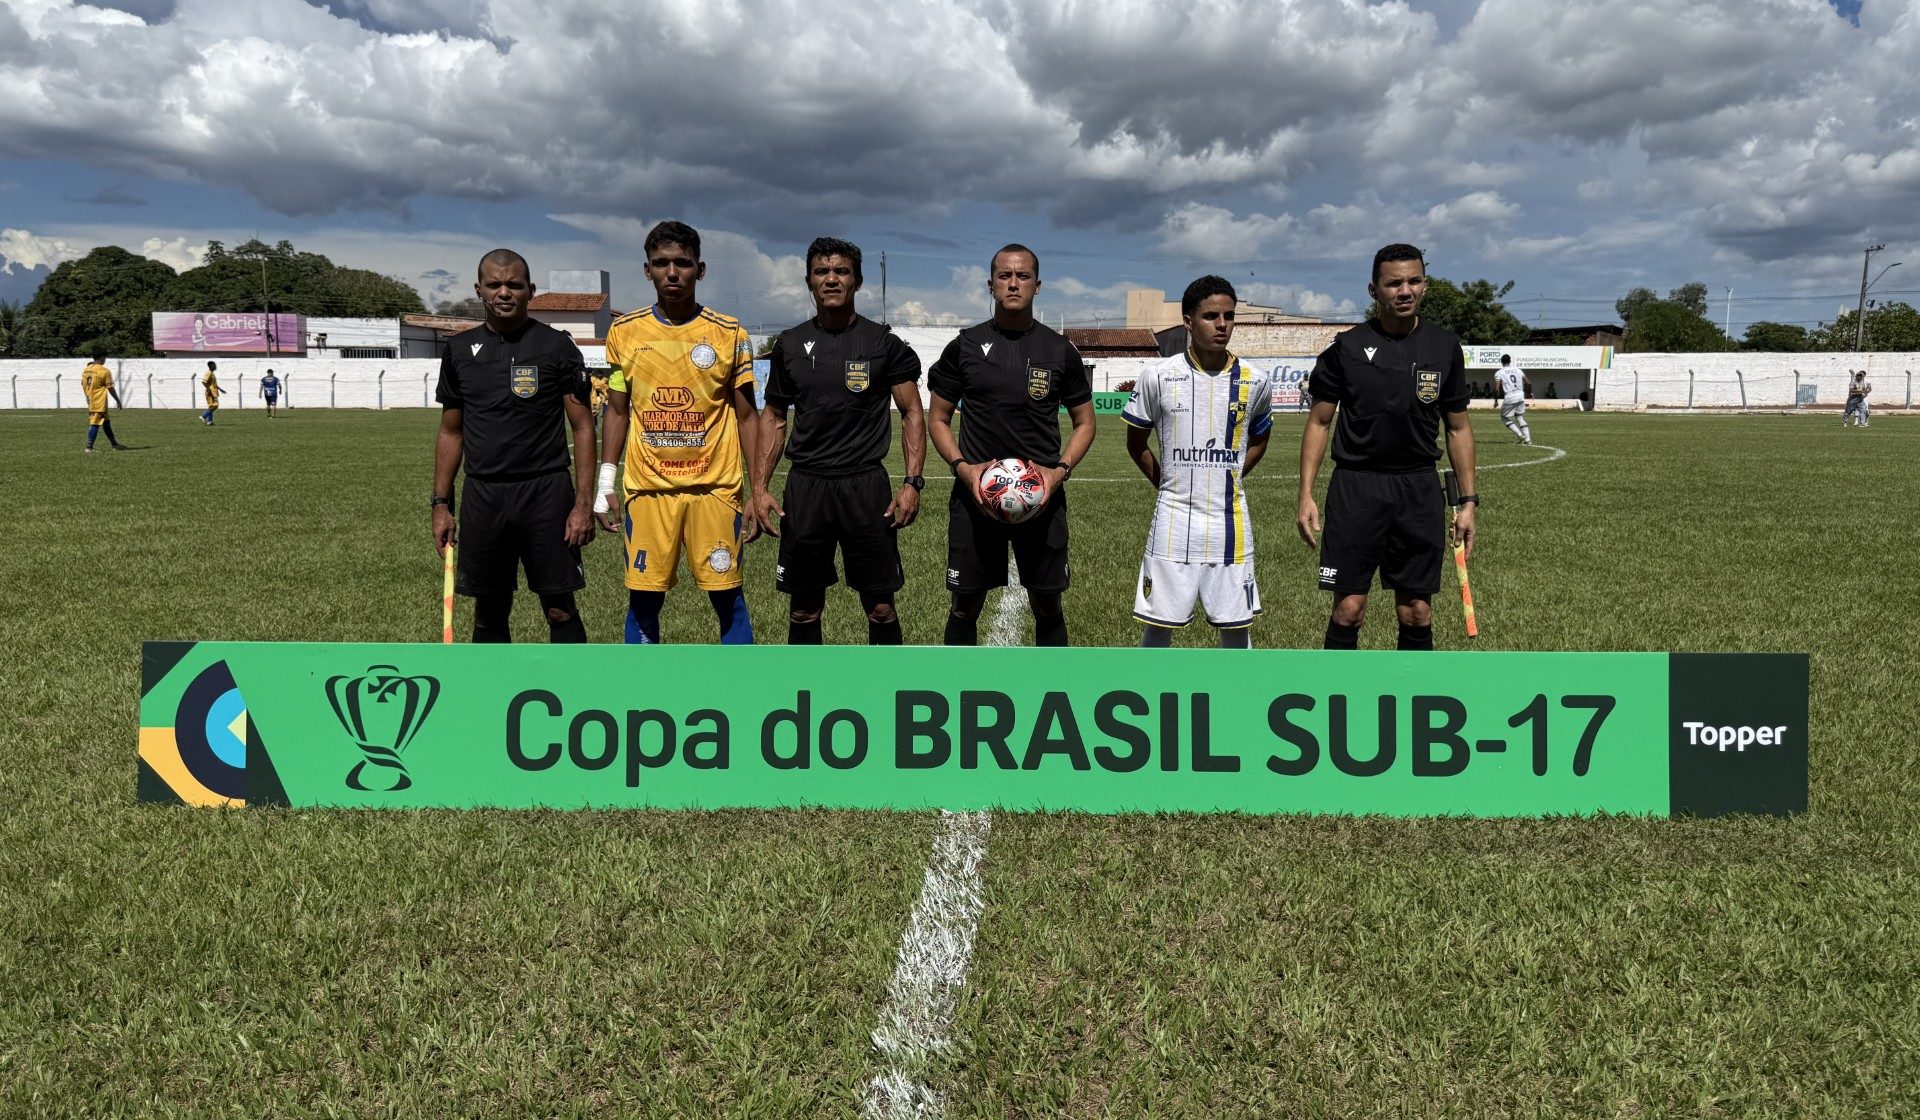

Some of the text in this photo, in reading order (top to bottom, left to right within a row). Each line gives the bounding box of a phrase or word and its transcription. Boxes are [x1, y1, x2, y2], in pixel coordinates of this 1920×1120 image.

[205, 314, 272, 330] Gabriela
[849, 363, 866, 371] CBF
[1032, 370, 1048, 378] CBF
[1420, 373, 1437, 381] CBF
[643, 411, 704, 422] MARMORARIA
[644, 421, 705, 432] TOKI DE ARTE
[1173, 443, 1239, 463] nutrimax
[659, 460, 684, 469] COME
[659, 465, 709, 476] Pastelaria
[993, 474, 1033, 492] Topper
[633, 549, 647, 573] 4
[506, 689, 1617, 788] Copa do BRASIL SUB-17
[1682, 721, 1788, 752] Topper
